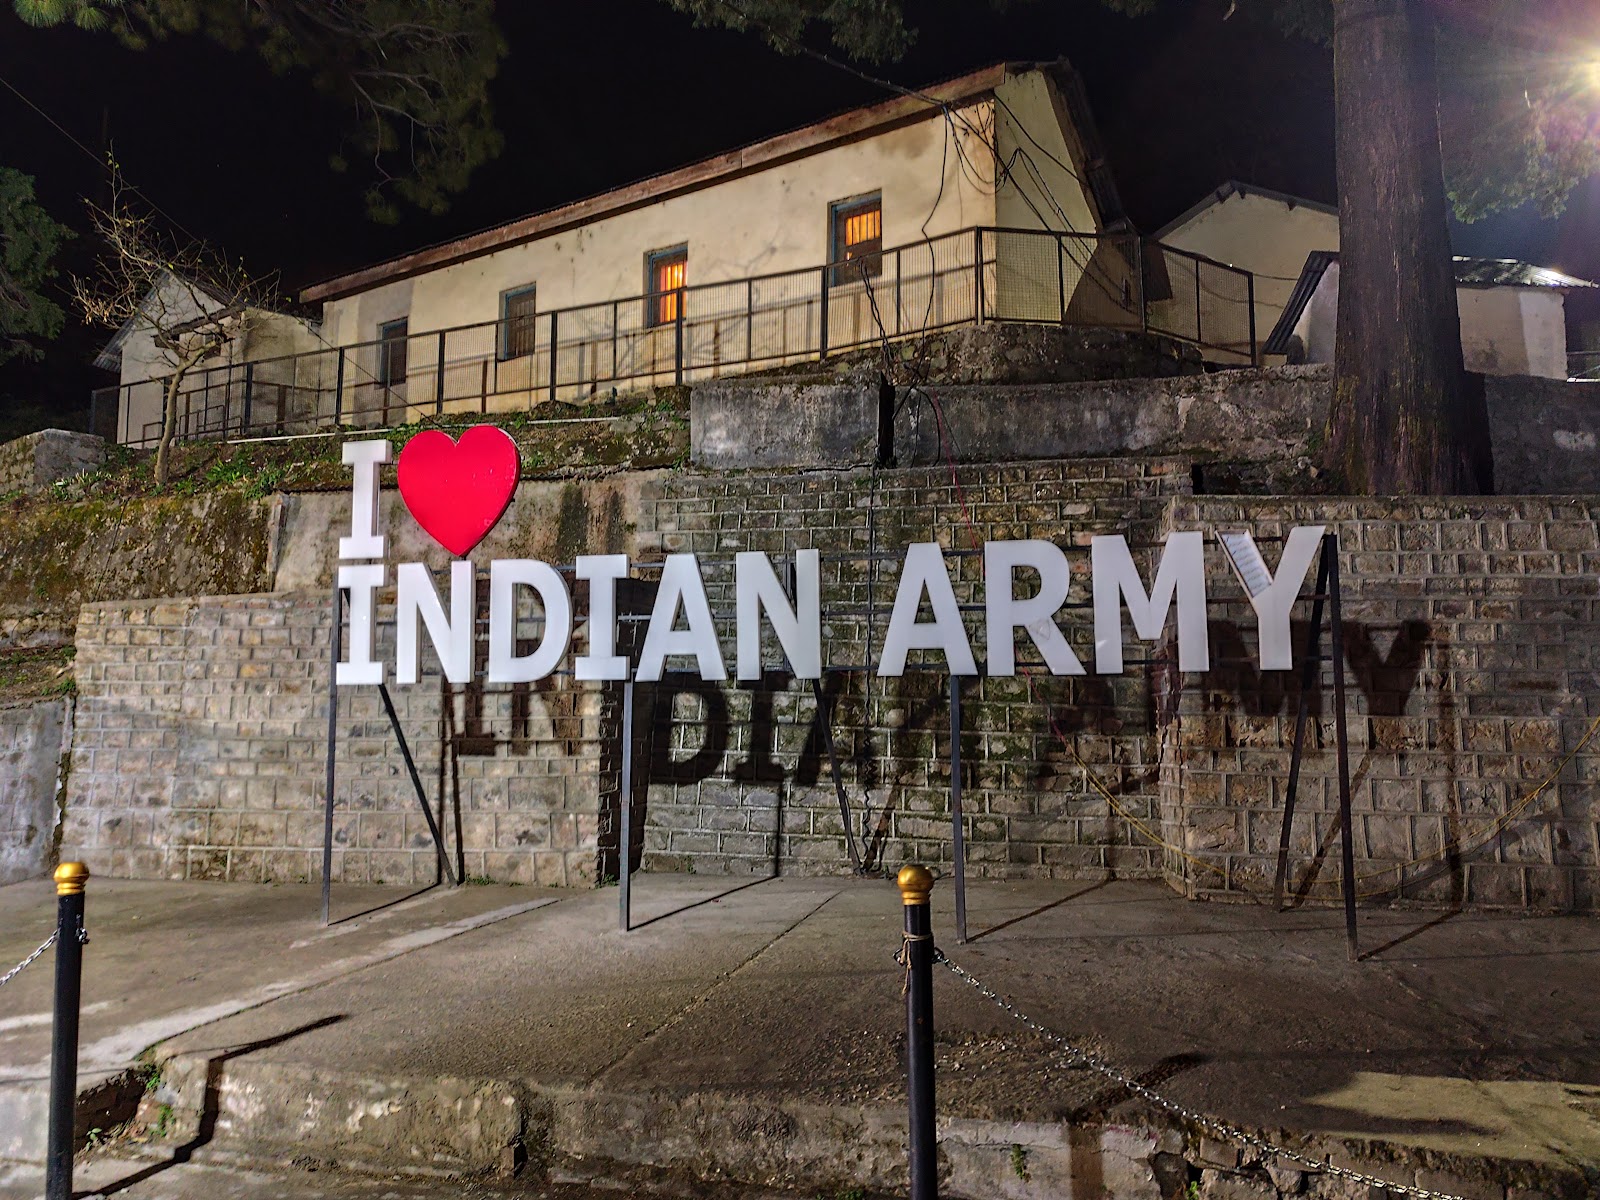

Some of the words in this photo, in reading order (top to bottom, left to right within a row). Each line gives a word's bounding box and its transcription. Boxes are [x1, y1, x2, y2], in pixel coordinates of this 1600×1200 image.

[338, 439, 392, 560] I
[335, 548, 822, 685] INDIAN
[876, 525, 1327, 677] ARMY
